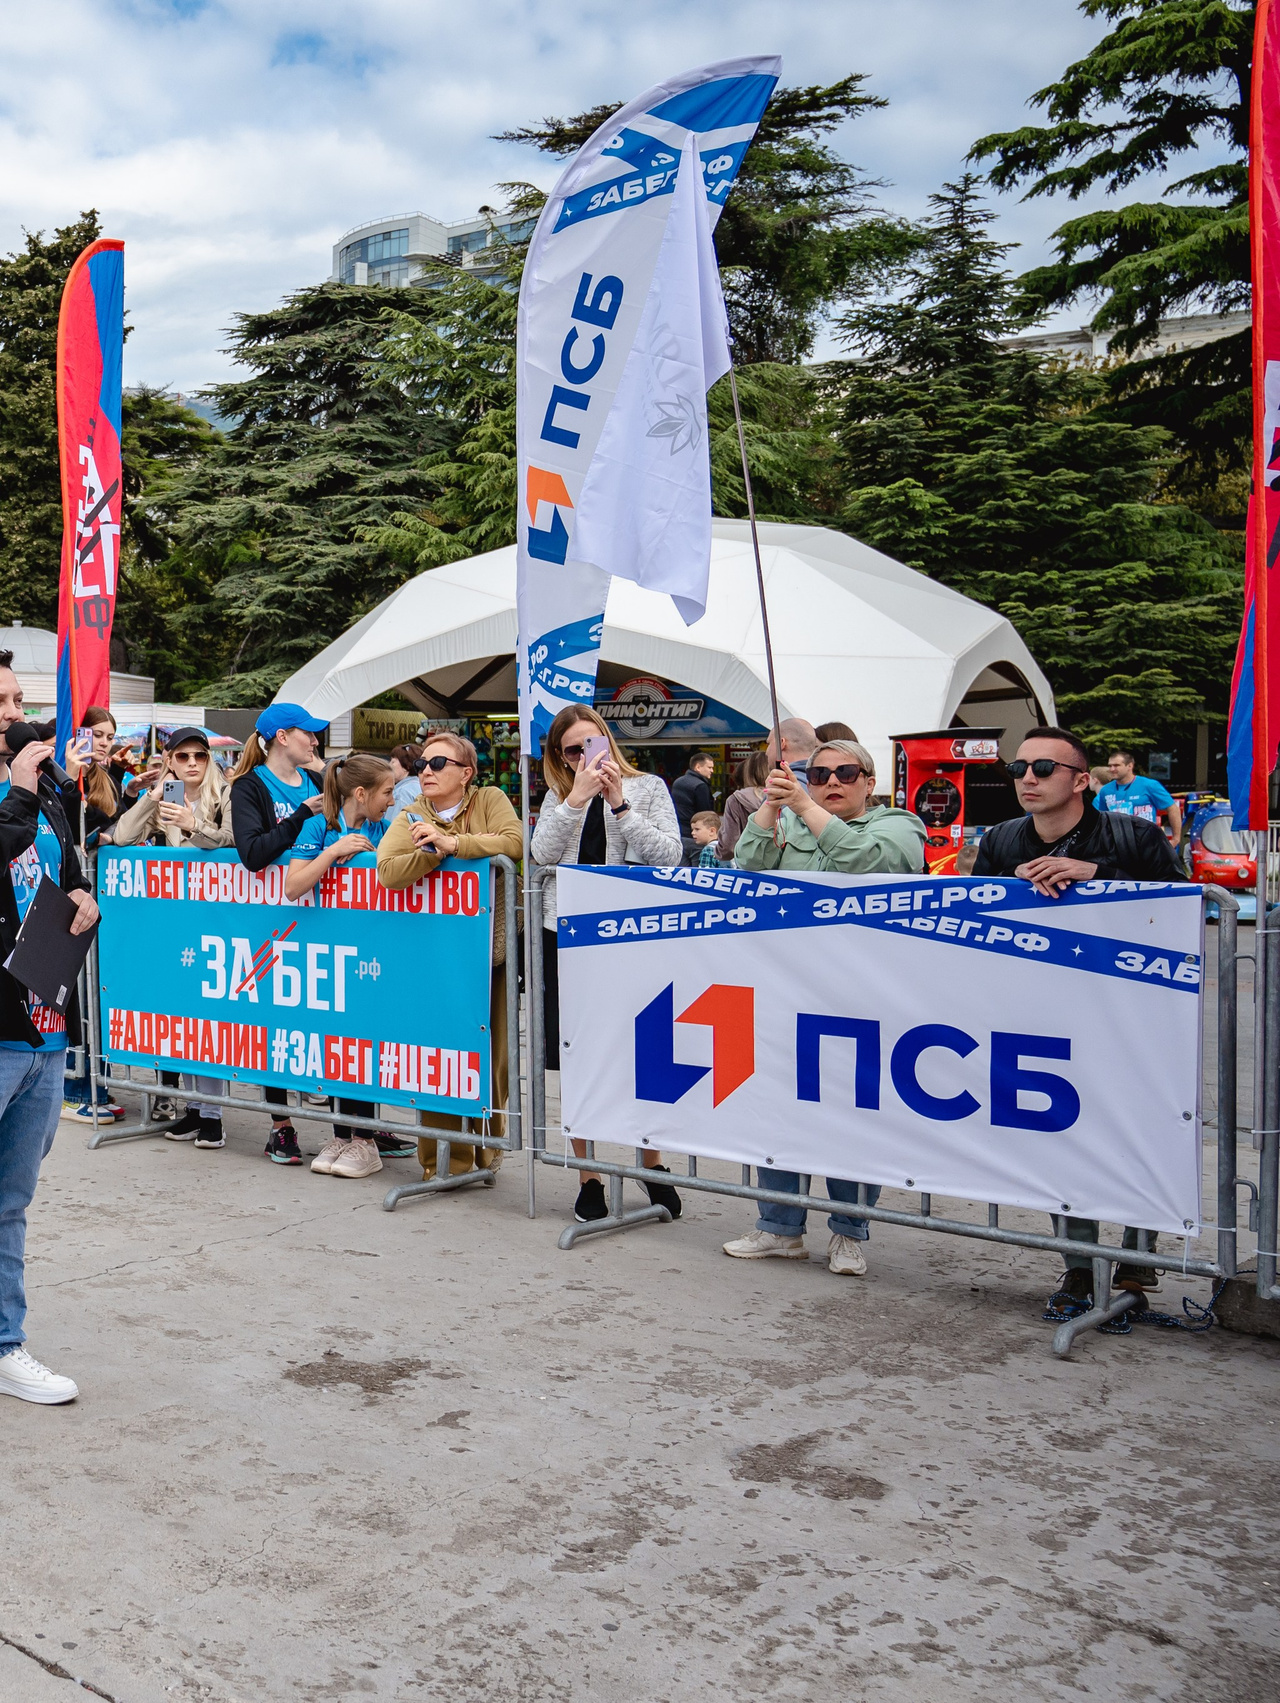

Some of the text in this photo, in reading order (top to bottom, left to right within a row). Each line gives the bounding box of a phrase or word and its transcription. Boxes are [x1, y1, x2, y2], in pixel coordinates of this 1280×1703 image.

[540, 272, 624, 449] ПСБ
[104, 857, 185, 900] #ЗАБЕГ
[597, 883, 1007, 938] ЗАБЕГ.РФ ЗАБЕГ.РФ
[109, 1008, 481, 1100] #АДРЕНАЛИН #ЗАБЕГ #ЦЕЛЬ
[796, 1012, 1081, 1133] ПСБ
